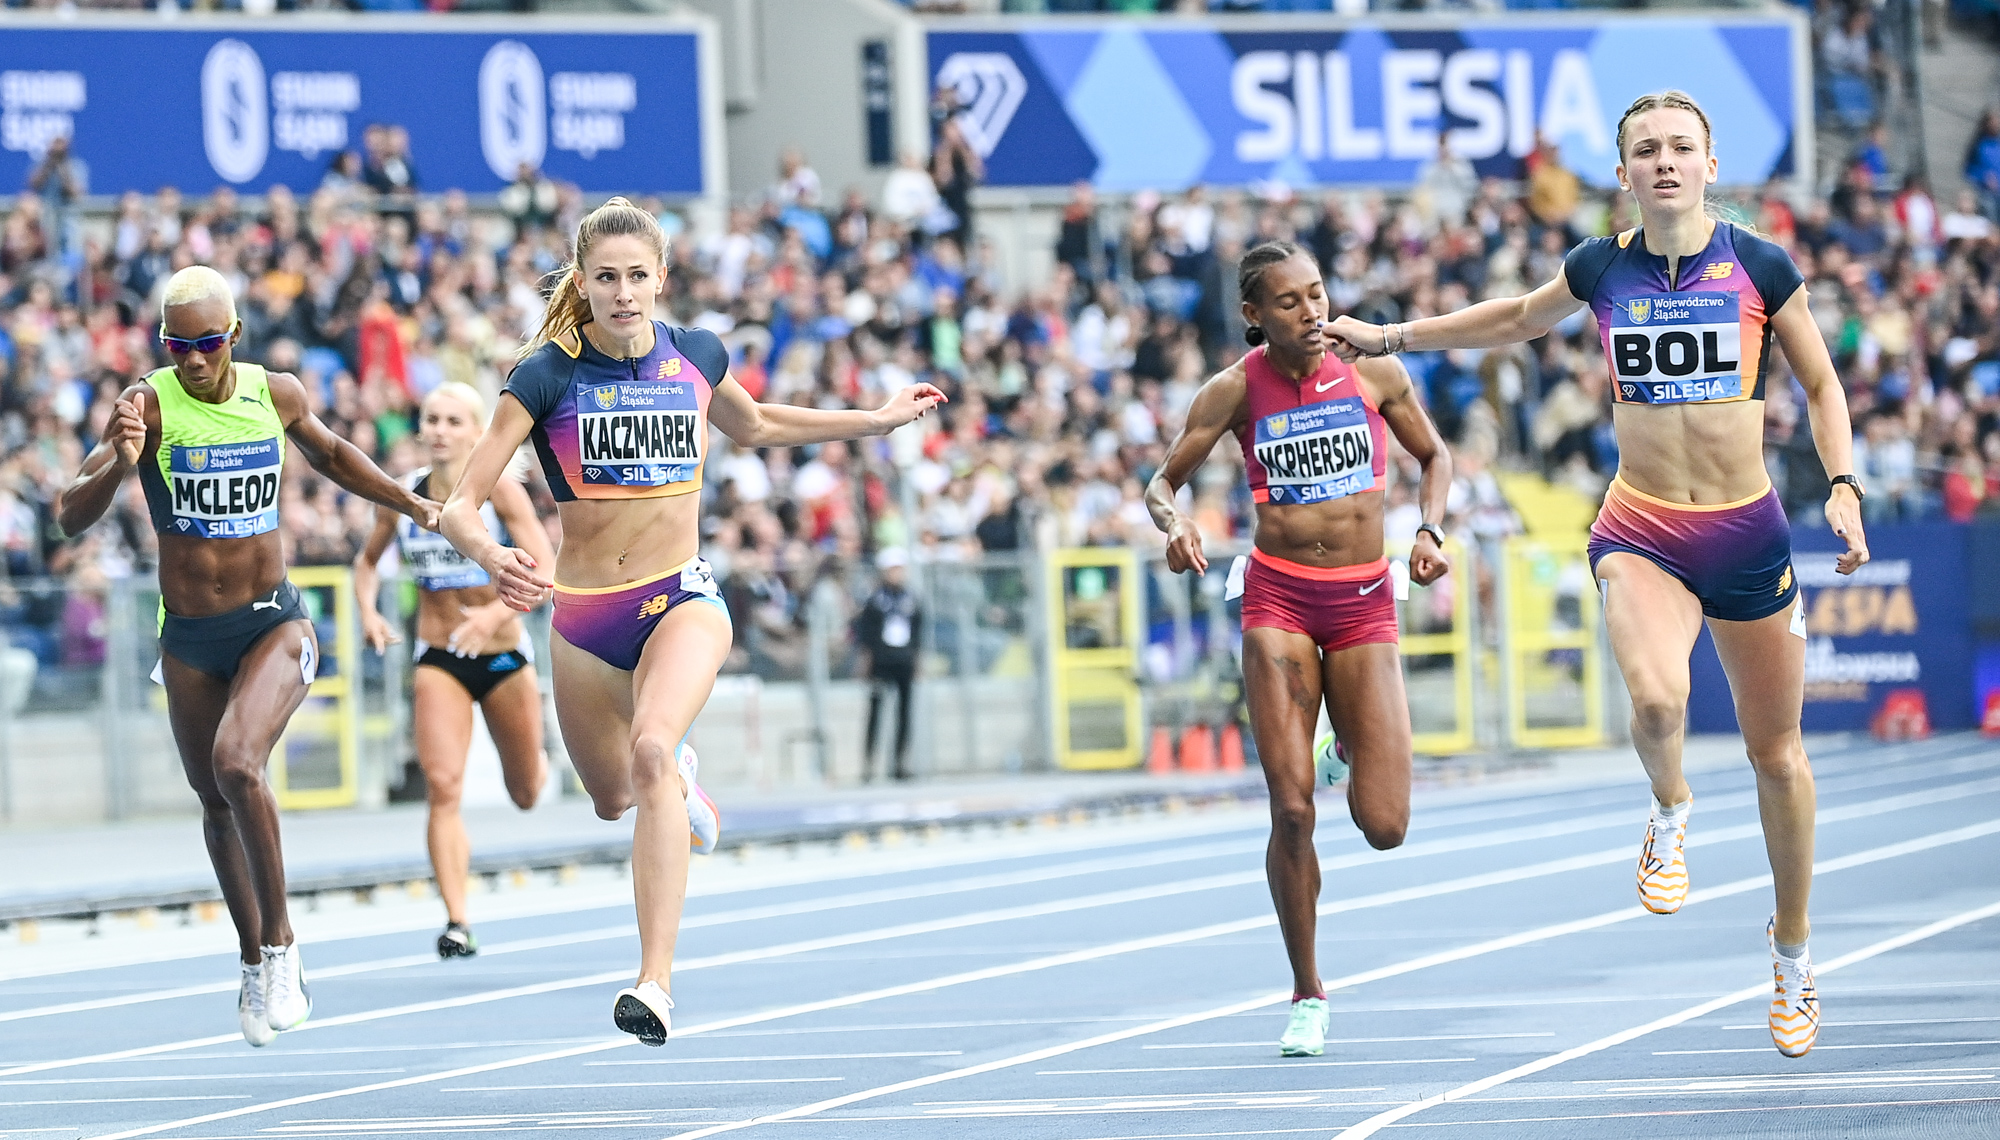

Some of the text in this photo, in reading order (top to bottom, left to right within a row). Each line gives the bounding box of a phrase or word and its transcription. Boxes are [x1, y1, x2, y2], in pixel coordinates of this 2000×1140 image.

[1231, 48, 1609, 161] SILESIA
[1653, 297, 1724, 310] Województwo
[1653, 310, 1690, 322] Śląskie
[1614, 331, 1738, 376] BOL
[620, 385, 683, 396] Województwo
[1653, 380, 1725, 399] SILESIA
[620, 396, 655, 407] Śląskie
[1290, 403, 1353, 422] Województwo
[1291, 418, 1325, 432] Śląskie
[582, 415, 698, 460] KACZMAREK
[210, 444, 271, 459] Województwo
[1258, 431, 1369, 478] MCPHERSON
[210, 457, 243, 469] Śląskie
[174, 473, 277, 515] MCLEOD
[1301, 475, 1361, 500] SILESIA
[208, 516, 267, 535] SILESIA
